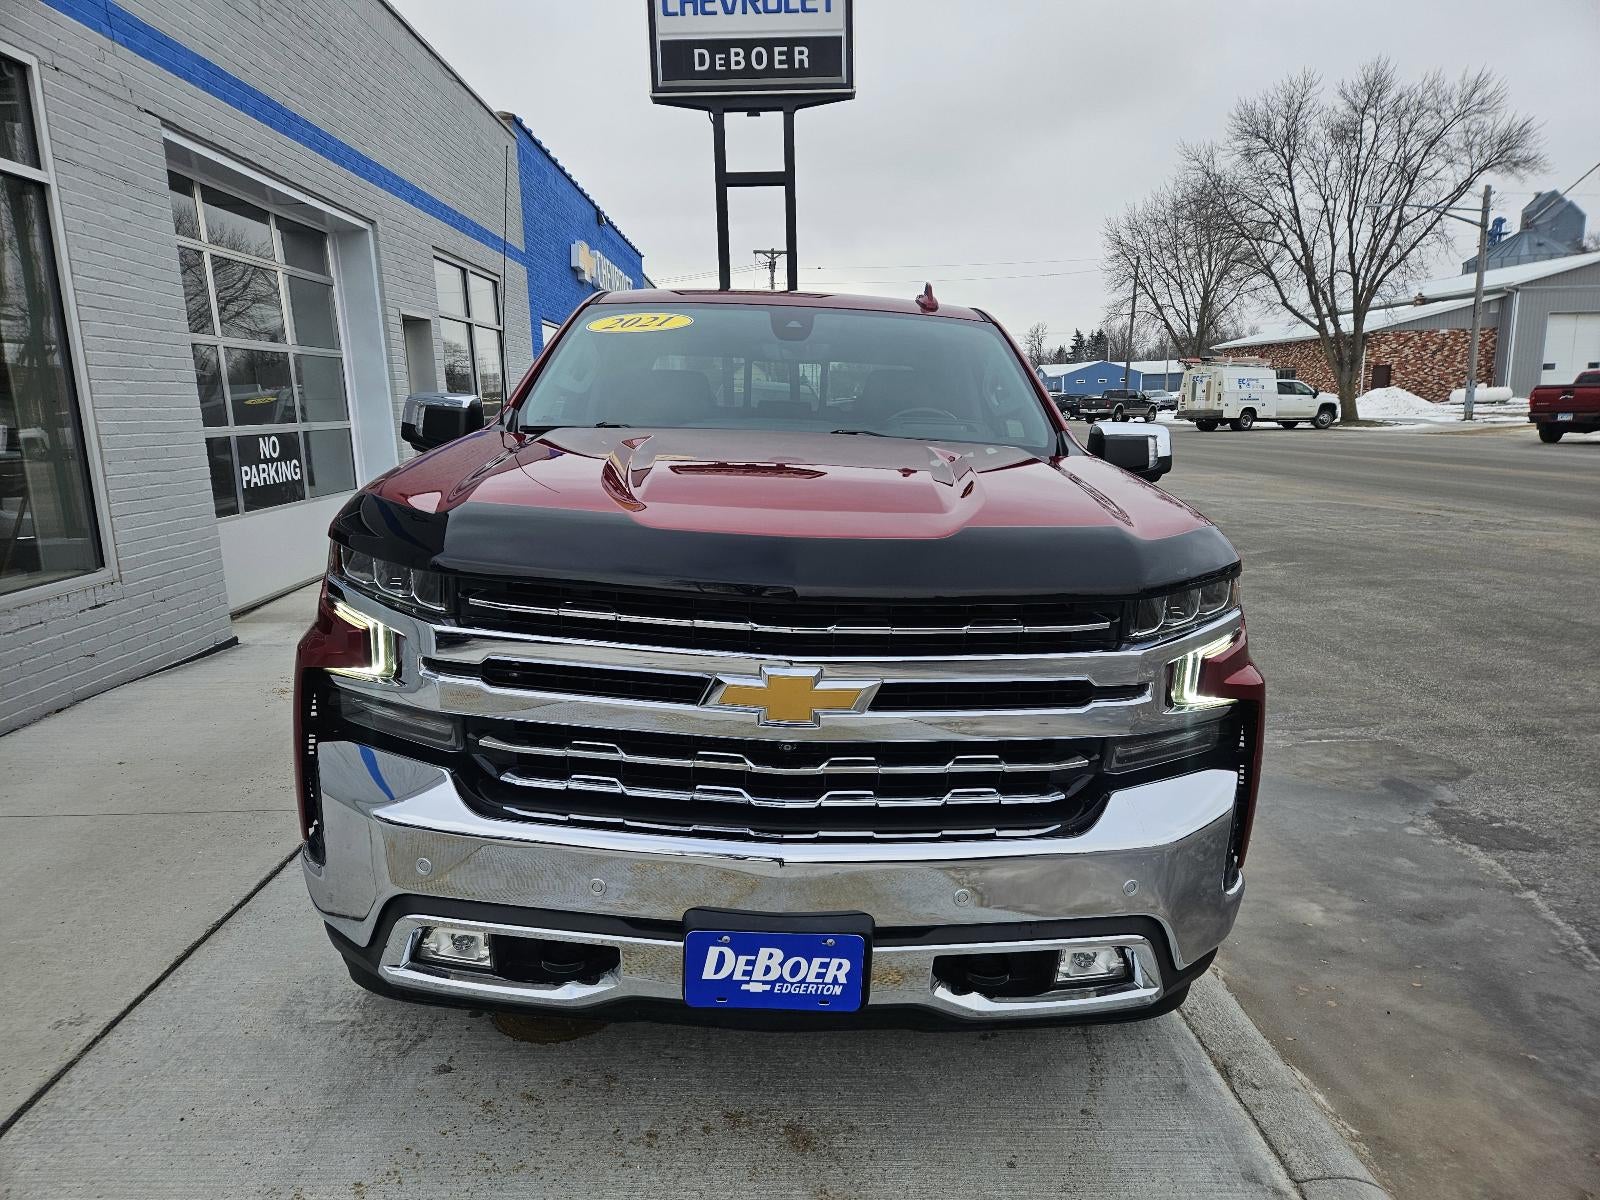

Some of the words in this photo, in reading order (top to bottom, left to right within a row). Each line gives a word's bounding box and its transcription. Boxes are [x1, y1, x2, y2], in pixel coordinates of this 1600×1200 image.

[602, 316, 675, 330] 2021
[258, 435, 280, 459] NO
[241, 459, 301, 489] PARKING
[774, 983, 843, 996] EDGERTON
